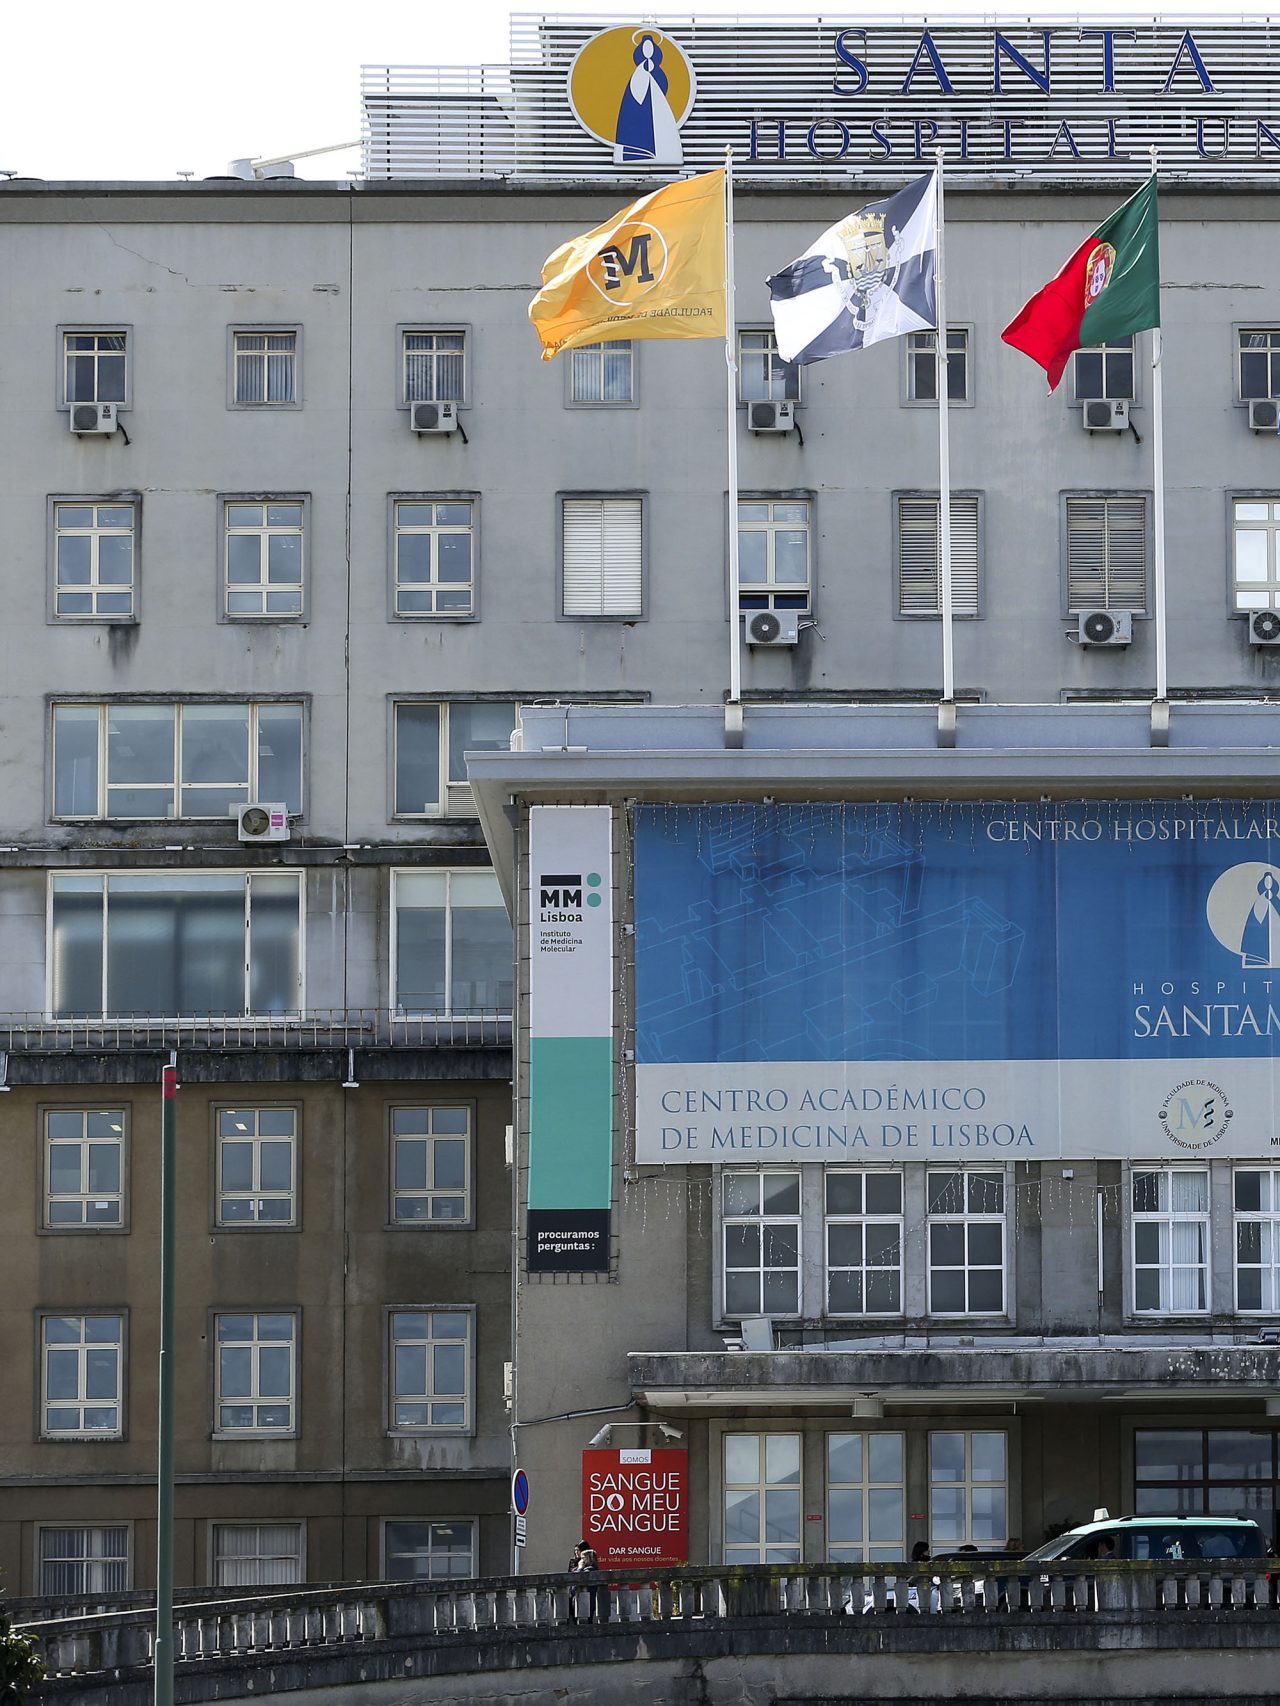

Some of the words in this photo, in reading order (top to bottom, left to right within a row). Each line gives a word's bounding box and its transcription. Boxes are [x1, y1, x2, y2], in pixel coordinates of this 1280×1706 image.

[832, 28, 1222, 96] SANTA
[745, 117, 1131, 161] HOSPITAL
[986, 820, 1102, 842] CENTRO
[540, 911, 583, 922] Lisboa
[661, 1089, 789, 1114] CENTRO
[799, 1083, 986, 1111] ACADÉMICO
[1162, 1079, 1195, 1108] FACULDADE
[1206, 1081, 1230, 1107] MEDICINA
[660, 1127, 698, 1150] DE
[710, 1125, 870, 1149] MEDICINA
[881, 1124, 919, 1147] DE
[931, 1123, 1035, 1147] LISBOA
[1161, 1120, 1202, 1150] UNIVERSIDADE
[1202, 1140, 1214, 1148] DE
[1212, 1119, 1230, 1142] LISBOA
[537, 1231, 600, 1241] procuramos
[590, 1472, 680, 1491] SANGUE
[590, 1493, 625, 1511] DO
[632, 1493, 680, 1511] MEU
[590, 1513, 680, 1532] SANGUE
[609, 1547, 626, 1555] DAR
[627, 1546, 662, 1555] SANGUE
